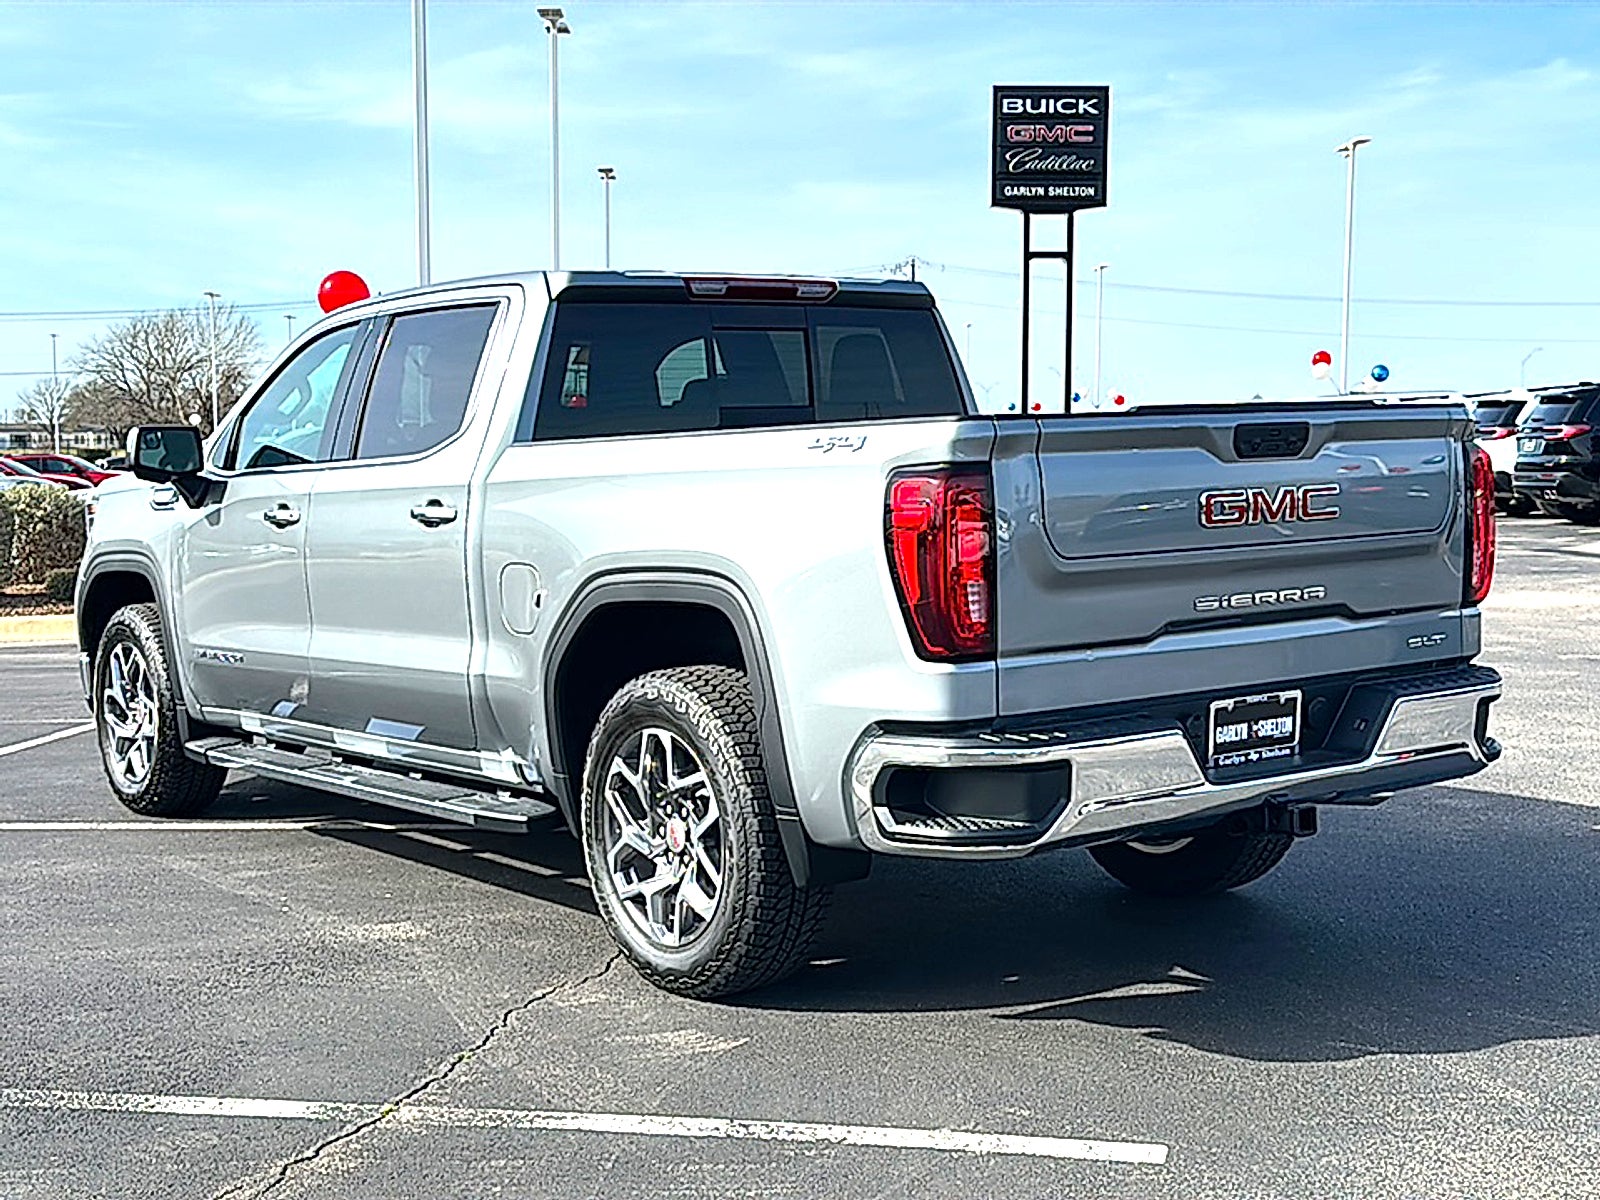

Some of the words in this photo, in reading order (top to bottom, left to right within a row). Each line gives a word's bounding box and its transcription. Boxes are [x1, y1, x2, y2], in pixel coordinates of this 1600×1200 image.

[1002, 98, 1099, 114] BUICK
[1006, 124, 1094, 142] GMC
[1005, 147, 1095, 173] Cadillac
[1004, 186, 1044, 197] GARLYN
[1048, 186, 1095, 197] SHELTON
[1199, 483, 1341, 528] GMC
[1194, 586, 1326, 610] SIERRA
[1407, 633, 1447, 649] SLT
